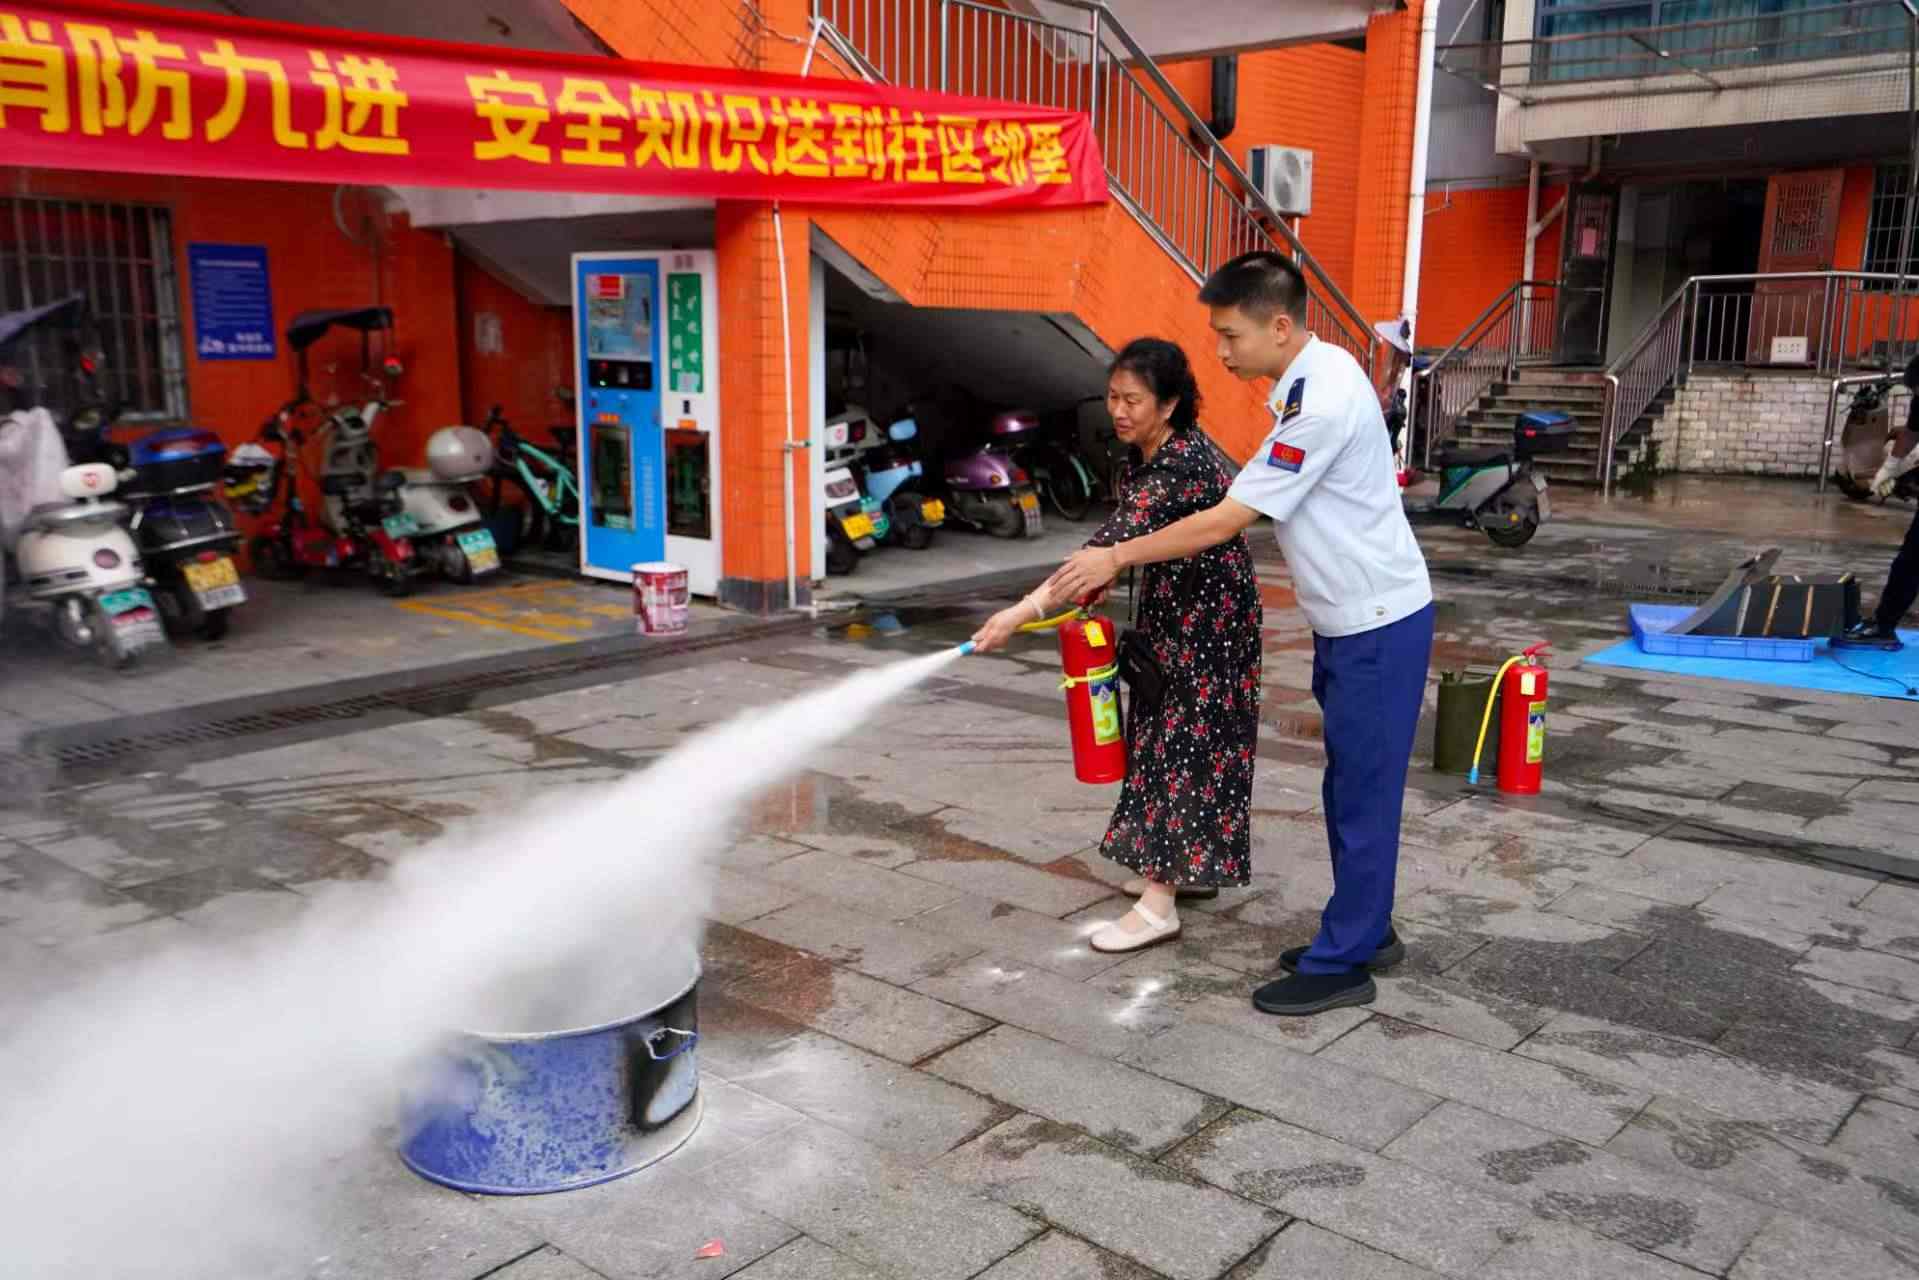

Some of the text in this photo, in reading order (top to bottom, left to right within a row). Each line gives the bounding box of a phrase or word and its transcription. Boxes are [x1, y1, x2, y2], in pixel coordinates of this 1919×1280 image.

[465, 70, 1073, 186] 安全知识送到社区邻里
